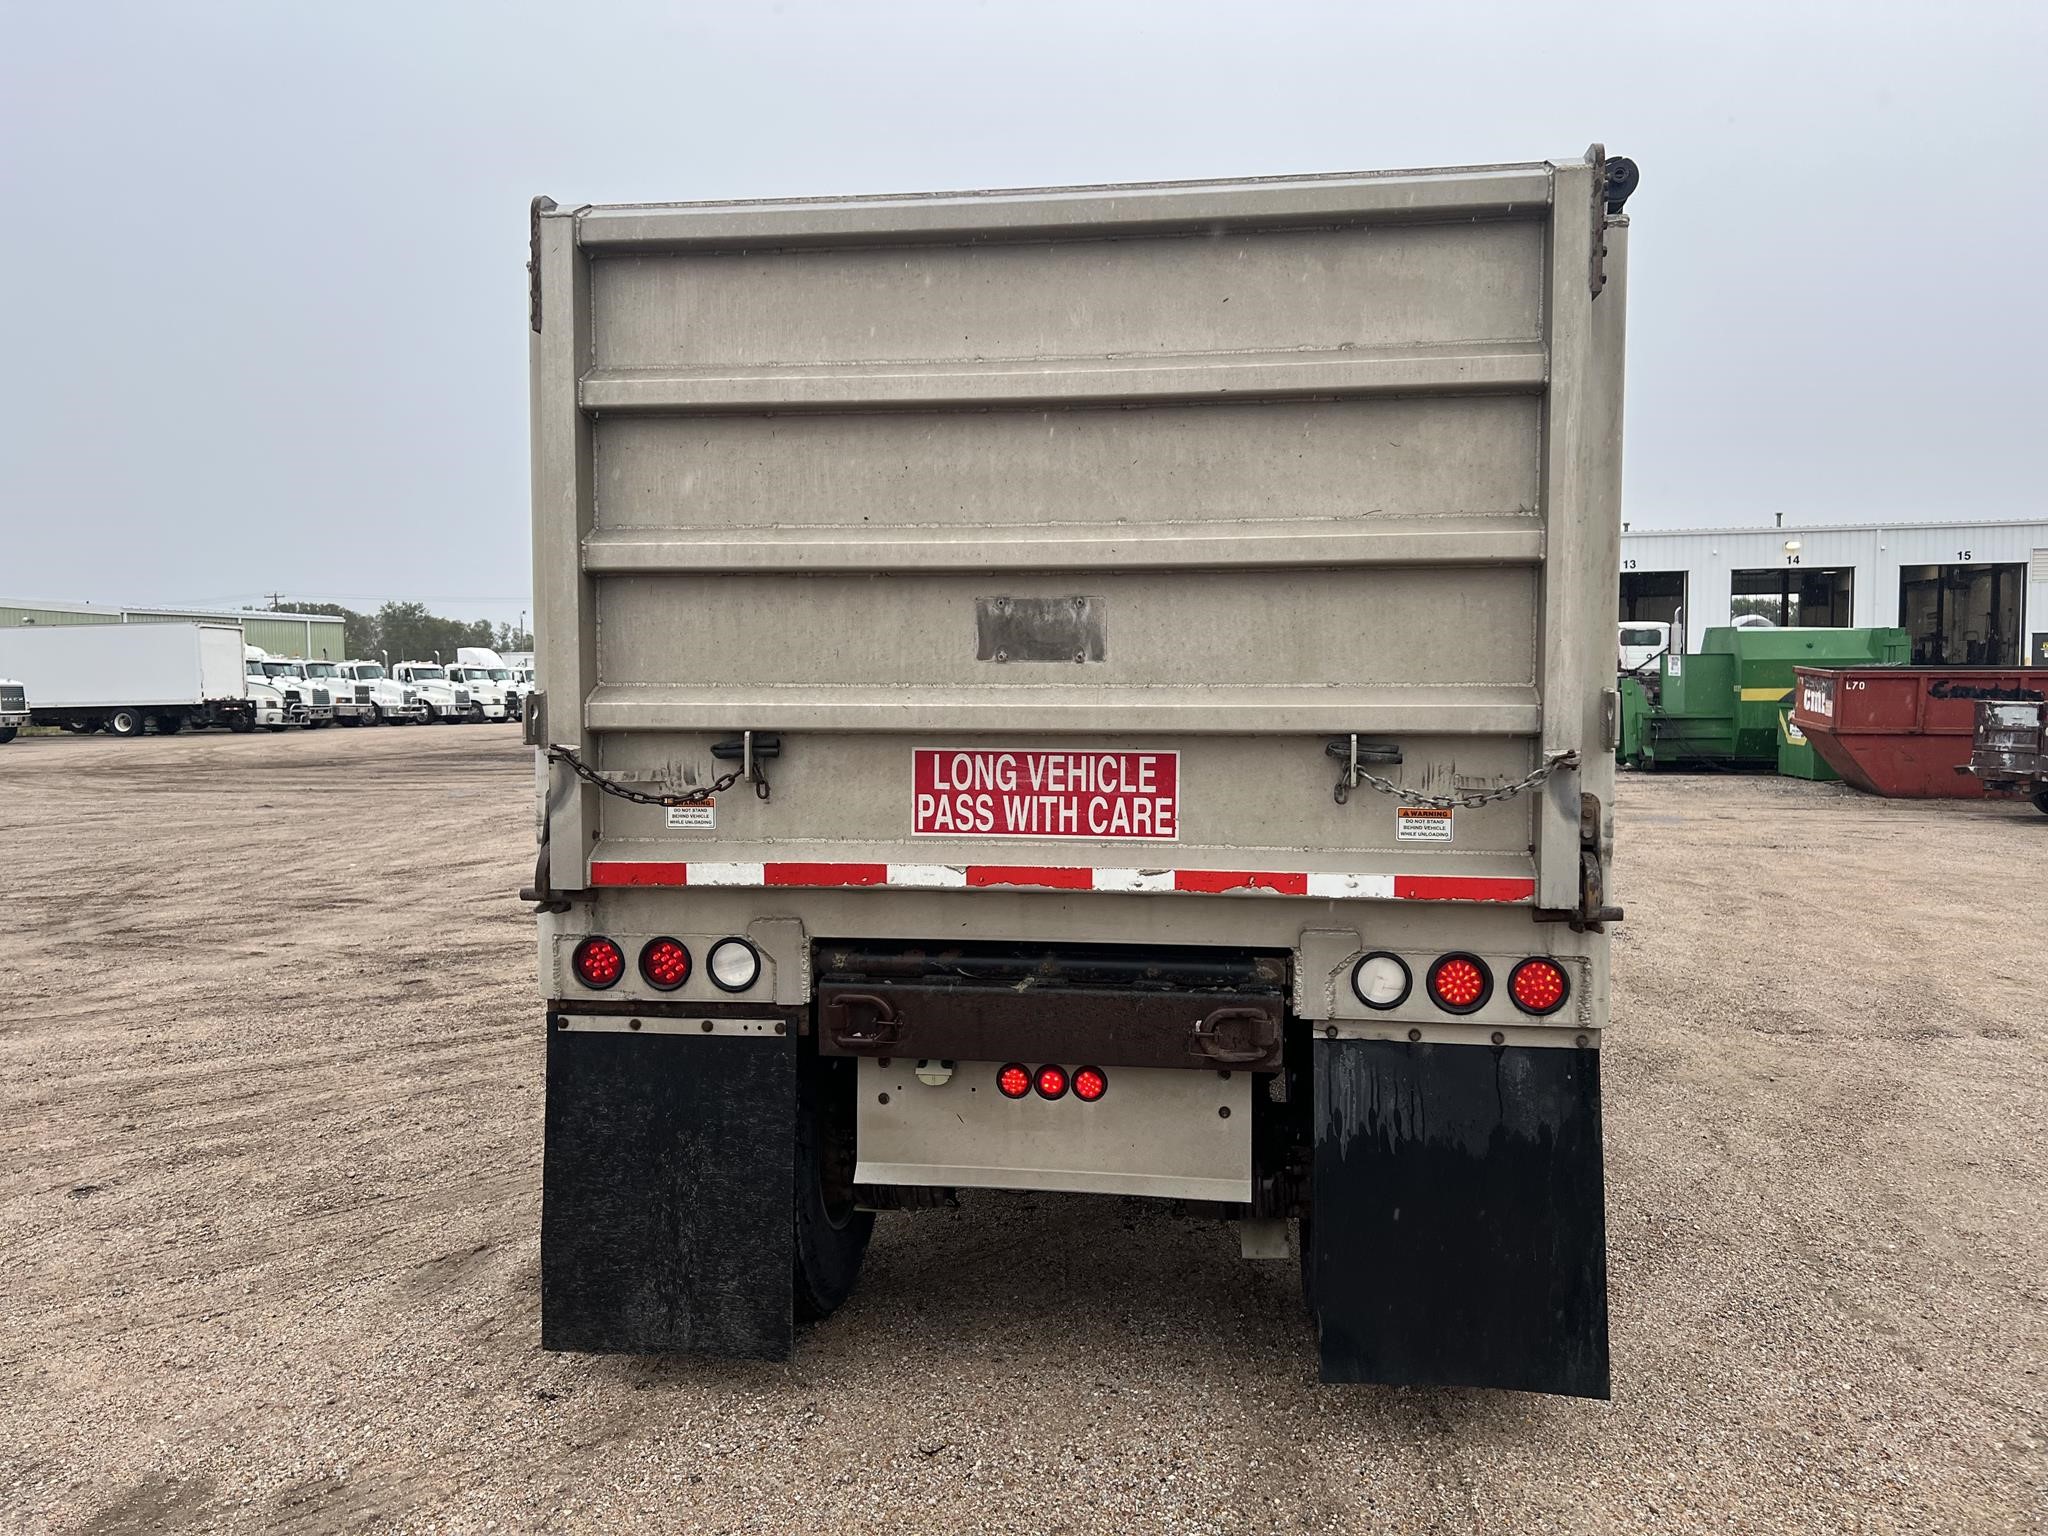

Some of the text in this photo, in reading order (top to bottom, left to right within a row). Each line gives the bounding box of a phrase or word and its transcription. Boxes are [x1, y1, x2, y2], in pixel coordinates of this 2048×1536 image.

[1786, 555, 1800, 565] 14
[1957, 550, 1972, 561] 15
[1623, 559, 1637, 569] 13
[1845, 681, 1866, 690] L70
[933, 753, 1157, 793] LONG VEHICLE
[917, 793, 1173, 835] PASS WITH CARE
